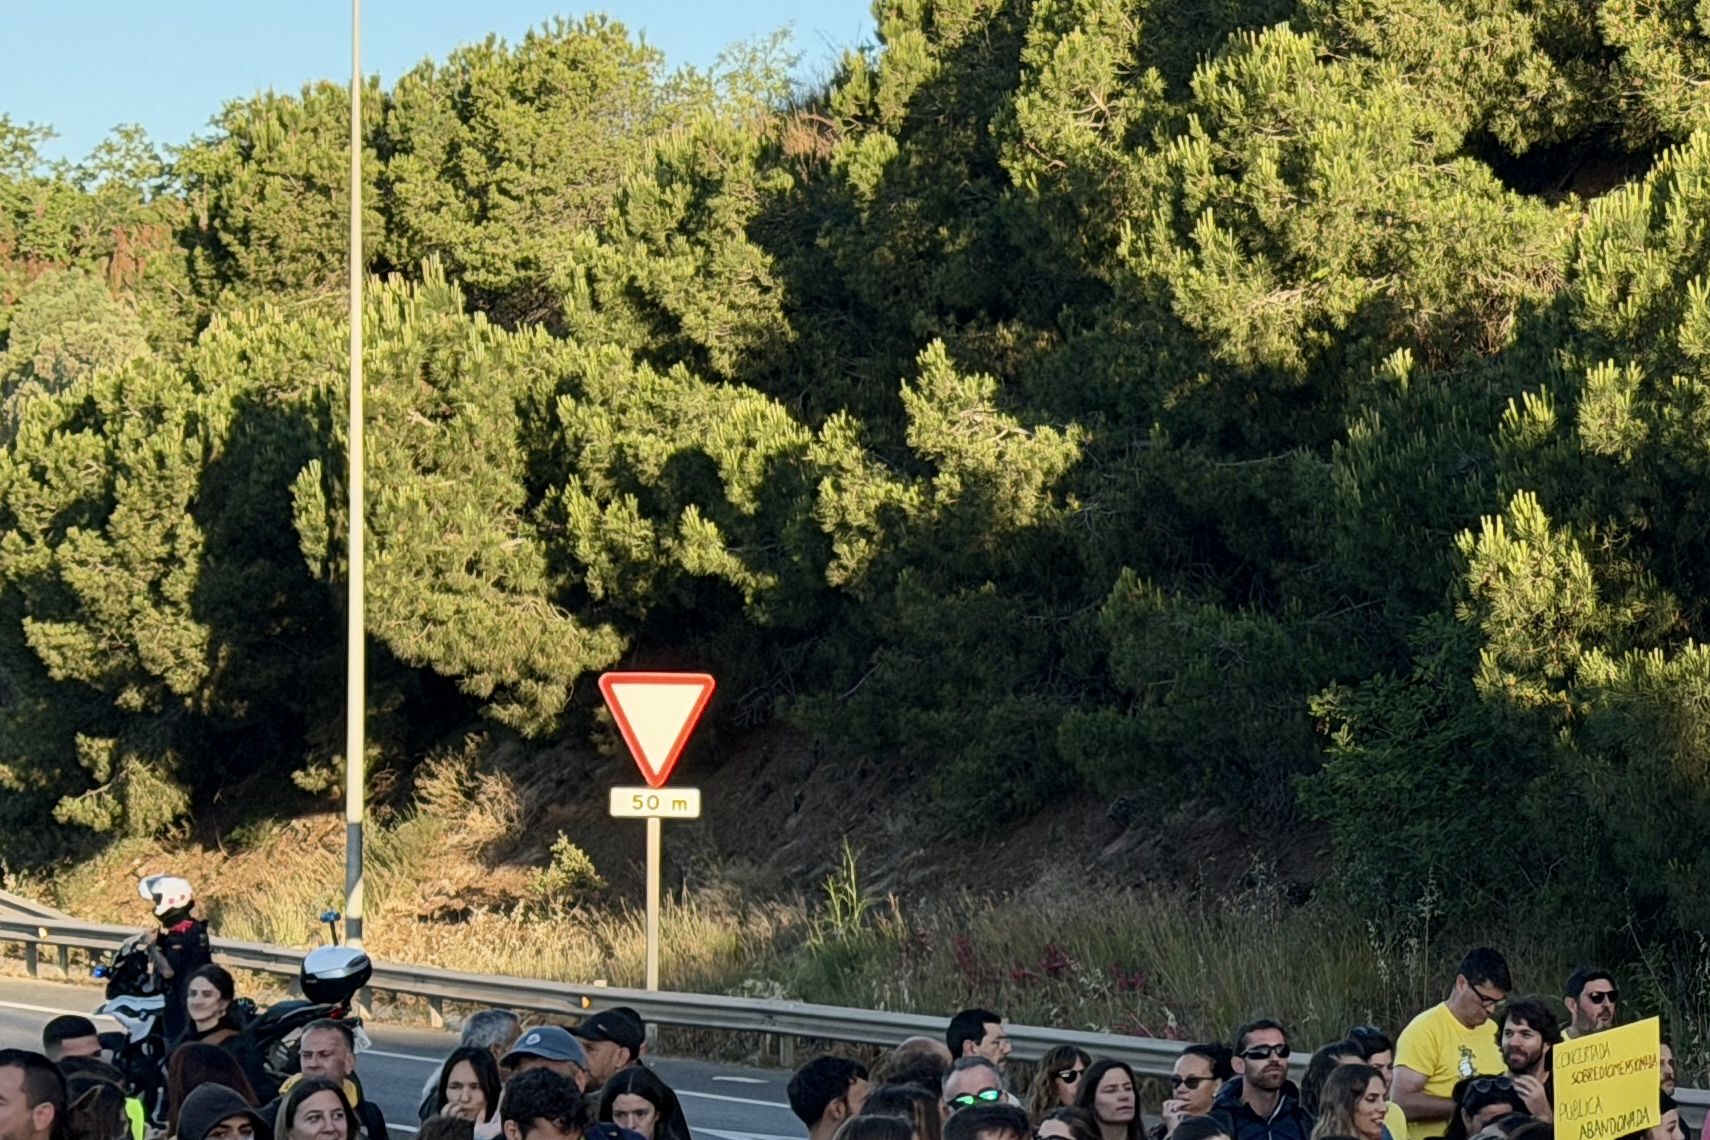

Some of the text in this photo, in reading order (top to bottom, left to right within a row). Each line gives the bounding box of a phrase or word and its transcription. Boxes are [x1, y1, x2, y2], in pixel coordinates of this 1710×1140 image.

[632, 794, 688, 811] 50 m
[1579, 1105, 1650, 1140] ABANDONADA
